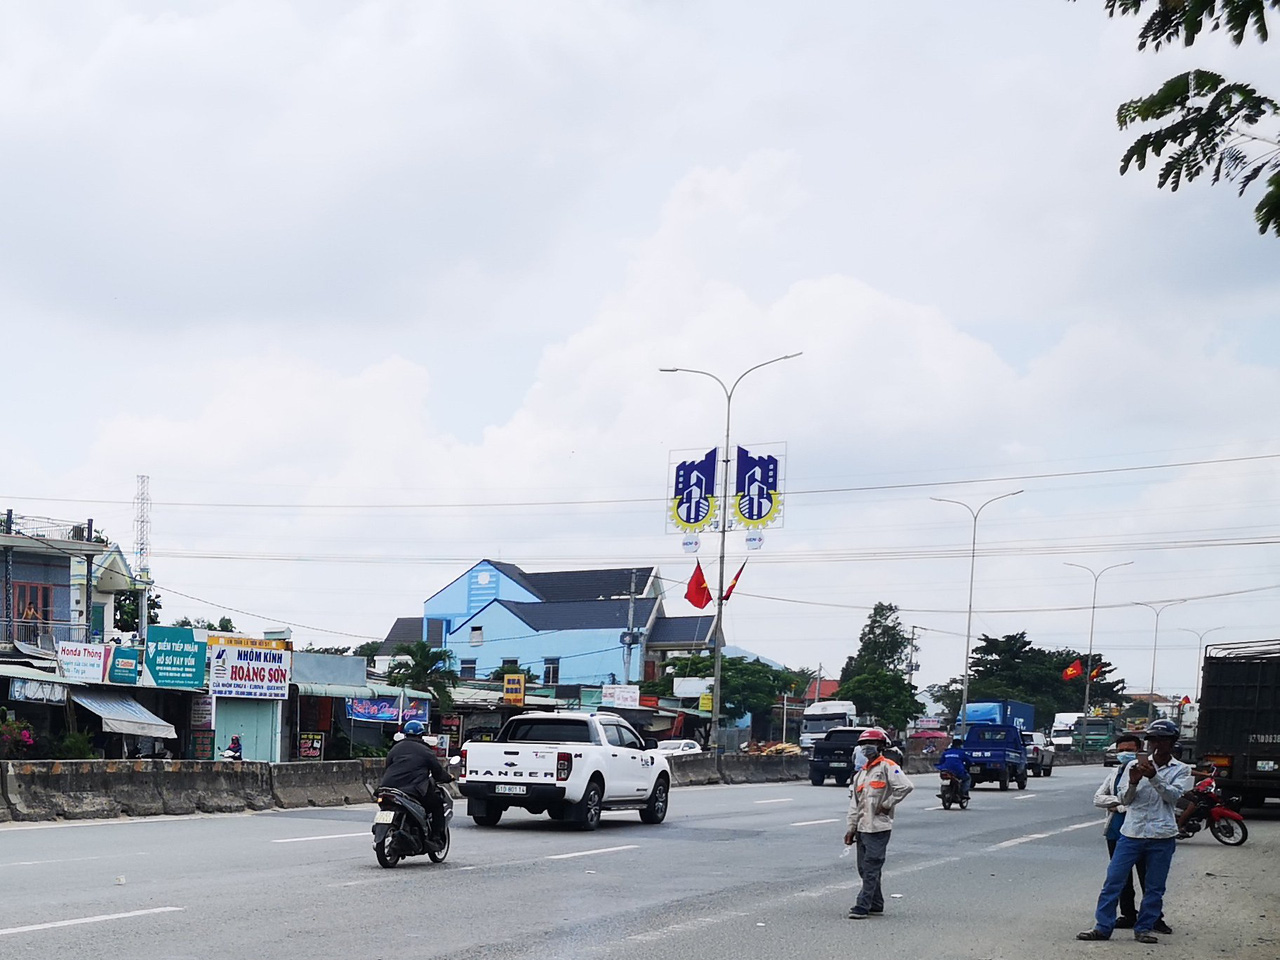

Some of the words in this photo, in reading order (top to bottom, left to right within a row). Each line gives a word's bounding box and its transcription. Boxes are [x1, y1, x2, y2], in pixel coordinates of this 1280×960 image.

[60, 646, 81, 657] Honda
[236, 648, 262, 663] NHÔM
[263, 650, 283, 664] KÍNH
[230, 662, 266, 683] HOÀNG
[267, 665, 288, 684] SƠN
[469, 769, 554, 778] RANGER
